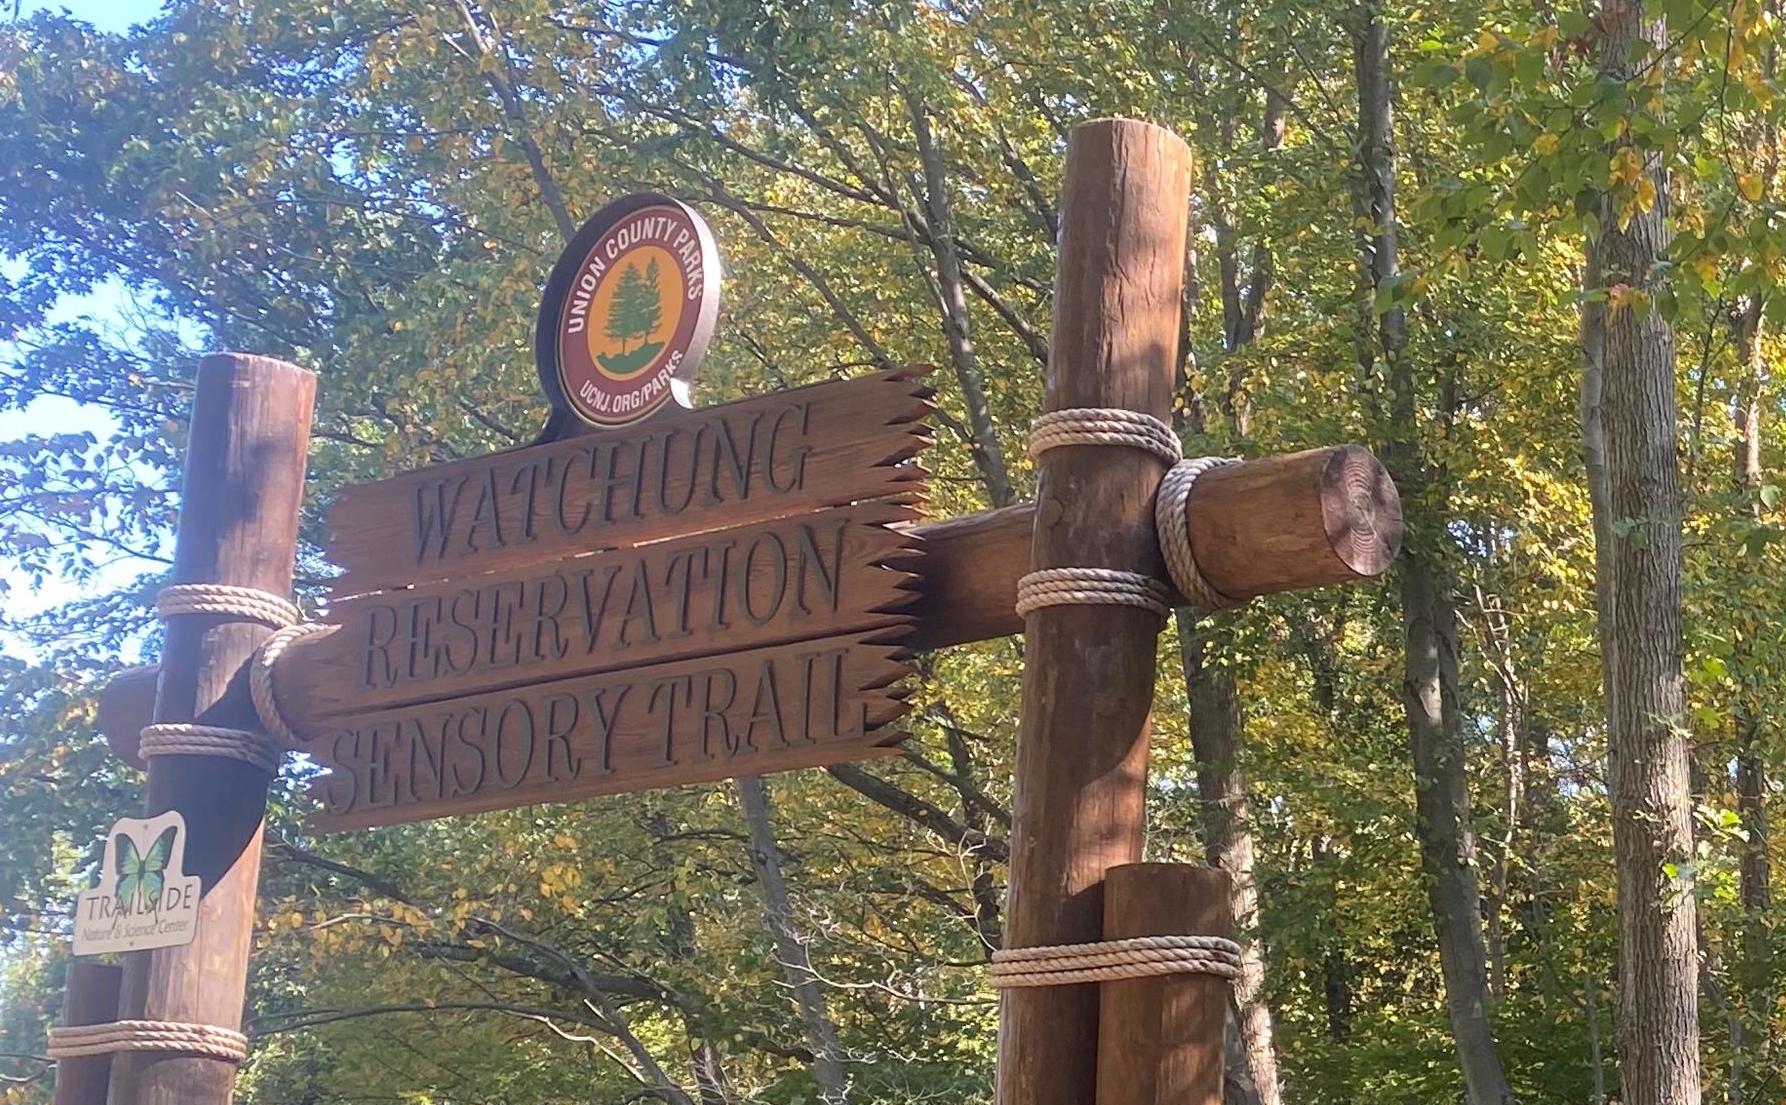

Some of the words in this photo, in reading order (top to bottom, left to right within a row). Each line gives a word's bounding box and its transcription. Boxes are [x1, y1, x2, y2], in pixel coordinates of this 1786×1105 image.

[568, 256, 605, 333] UNION
[606, 216, 677, 261] COUNTY
[673, 228, 704, 301] PARKS
[579, 350, 684, 413] UCNJ.ORG/PARKS
[411, 400, 812, 566] WATCHUNG
[362, 517, 849, 690] RESERVATION
[326, 684, 633, 816] SENSORY
[649, 648, 867, 769] TRAIL
[86, 884, 193, 920] TRAILSIDE
[159, 918, 189, 934] Center
